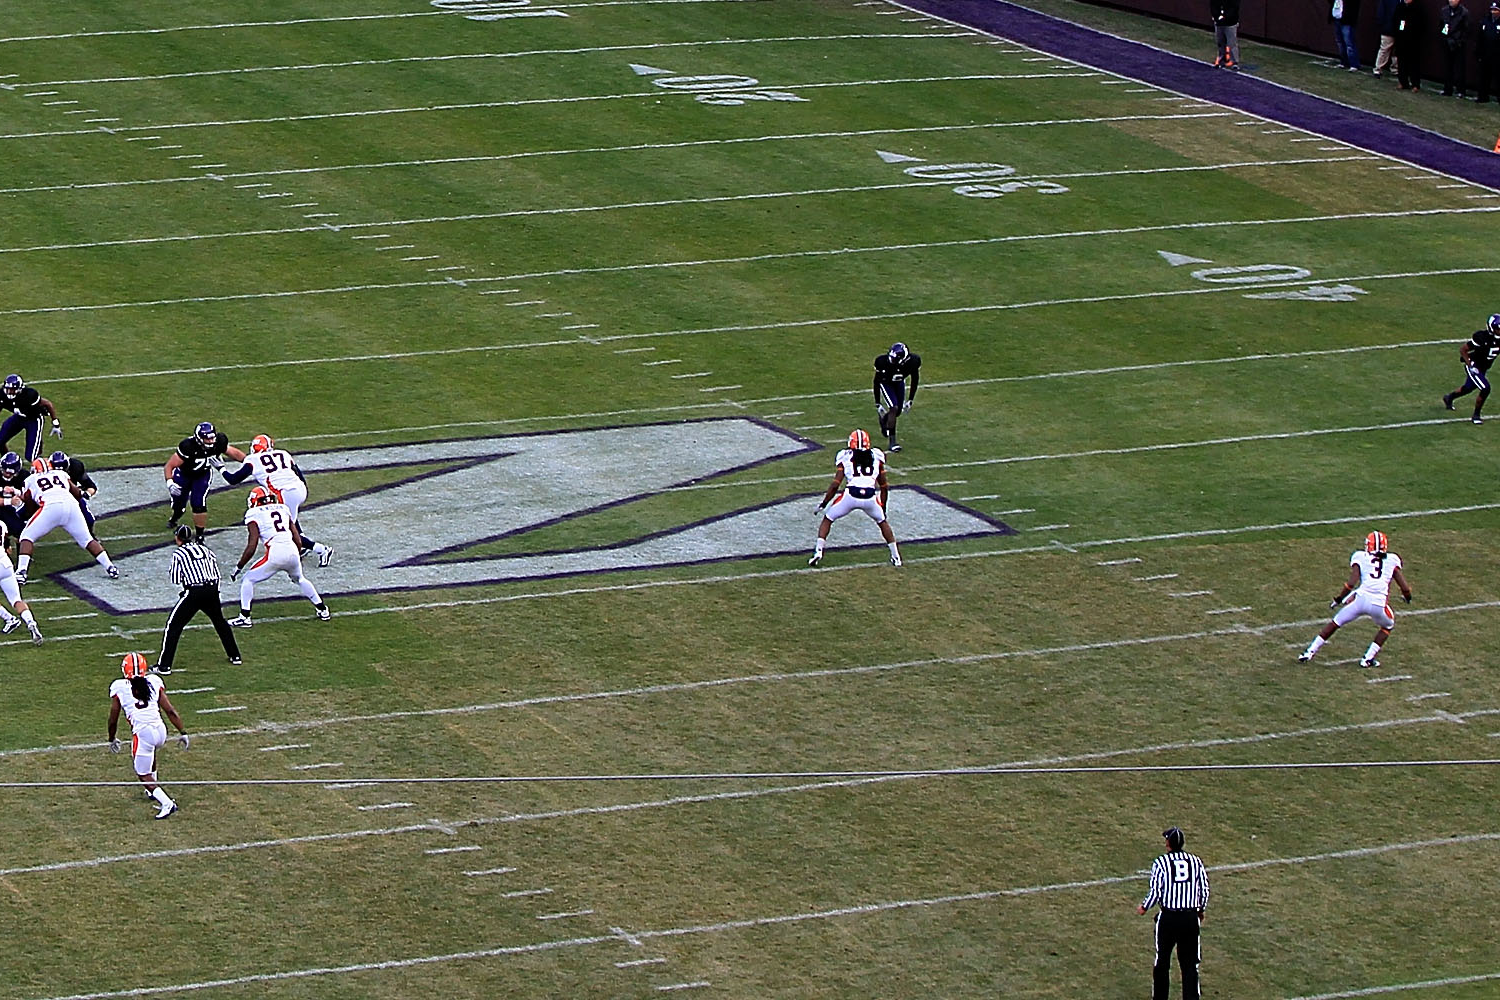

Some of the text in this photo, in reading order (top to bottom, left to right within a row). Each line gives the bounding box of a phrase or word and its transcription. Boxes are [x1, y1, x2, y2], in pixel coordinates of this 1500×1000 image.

[260, 452, 288, 474] 97
[270, 510, 287, 533] 2
[1369, 557, 1384, 580] 3
[1173, 859, 1190, 882] B
